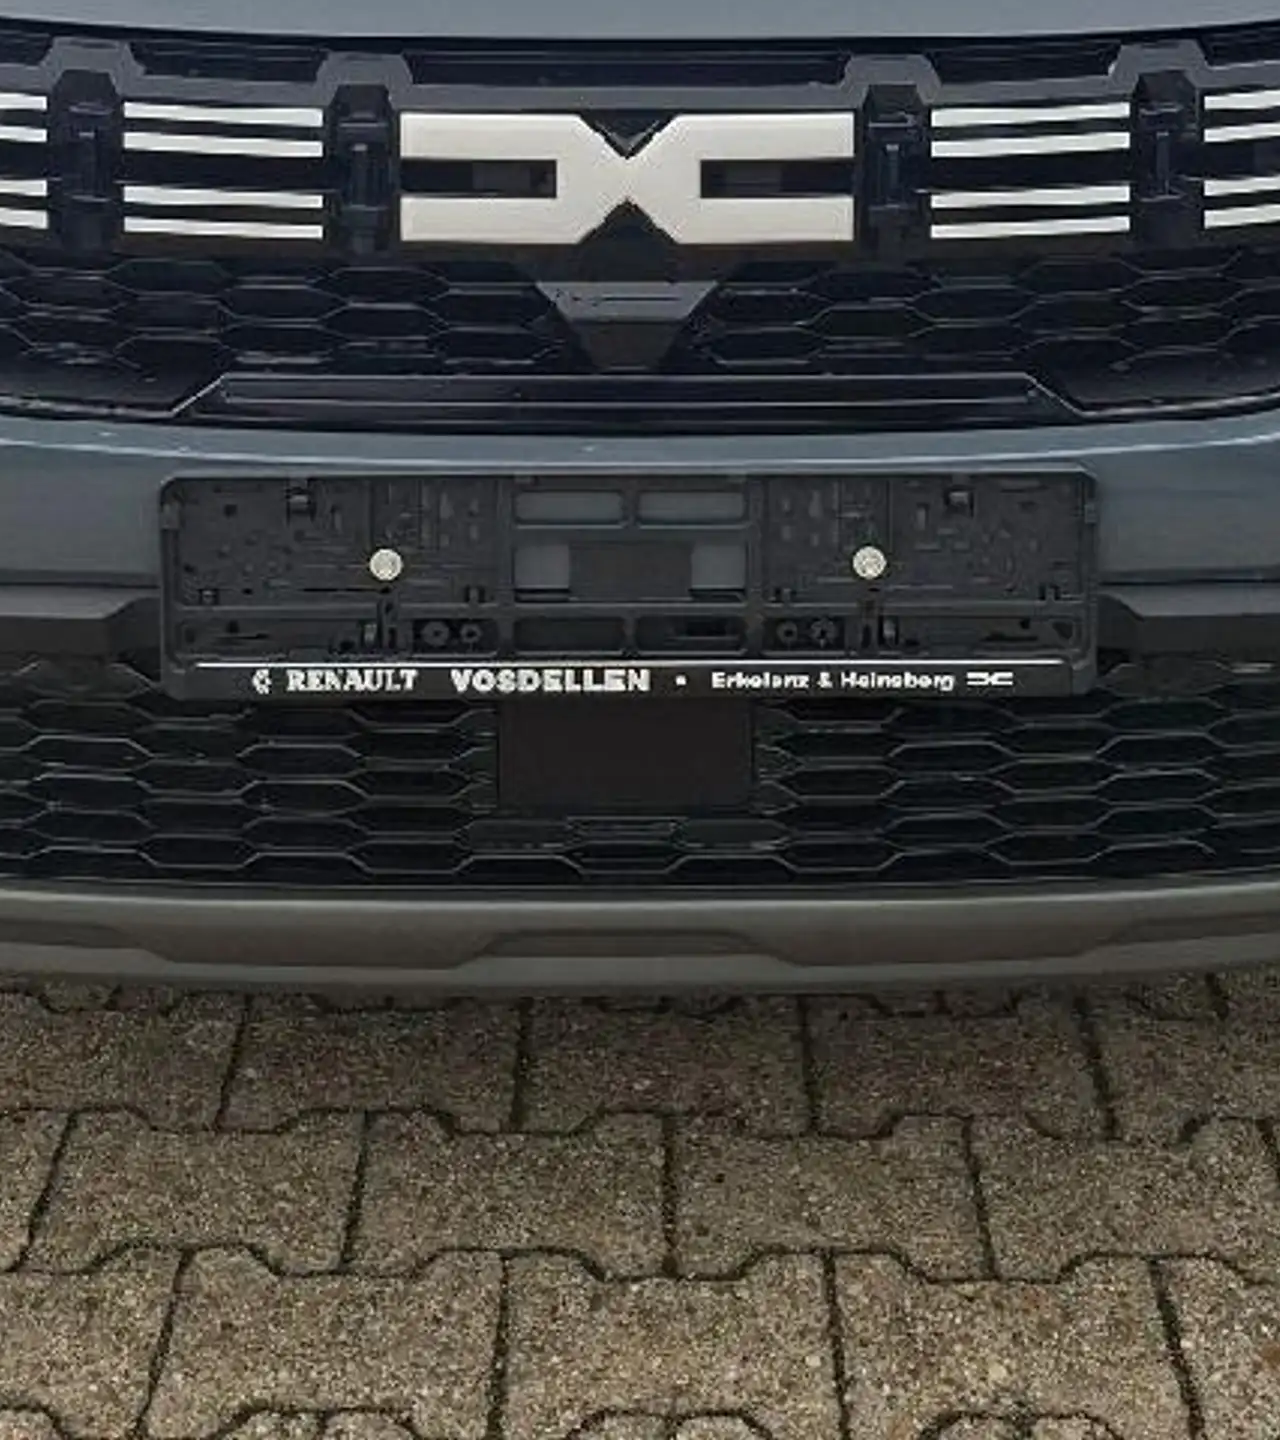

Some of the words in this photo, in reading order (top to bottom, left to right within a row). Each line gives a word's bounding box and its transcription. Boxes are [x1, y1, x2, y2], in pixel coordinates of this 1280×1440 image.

[286, 668, 419, 692] RENAULT
[450, 668, 651, 693] VOSDELLEN
[816, 671, 833, 689] &
